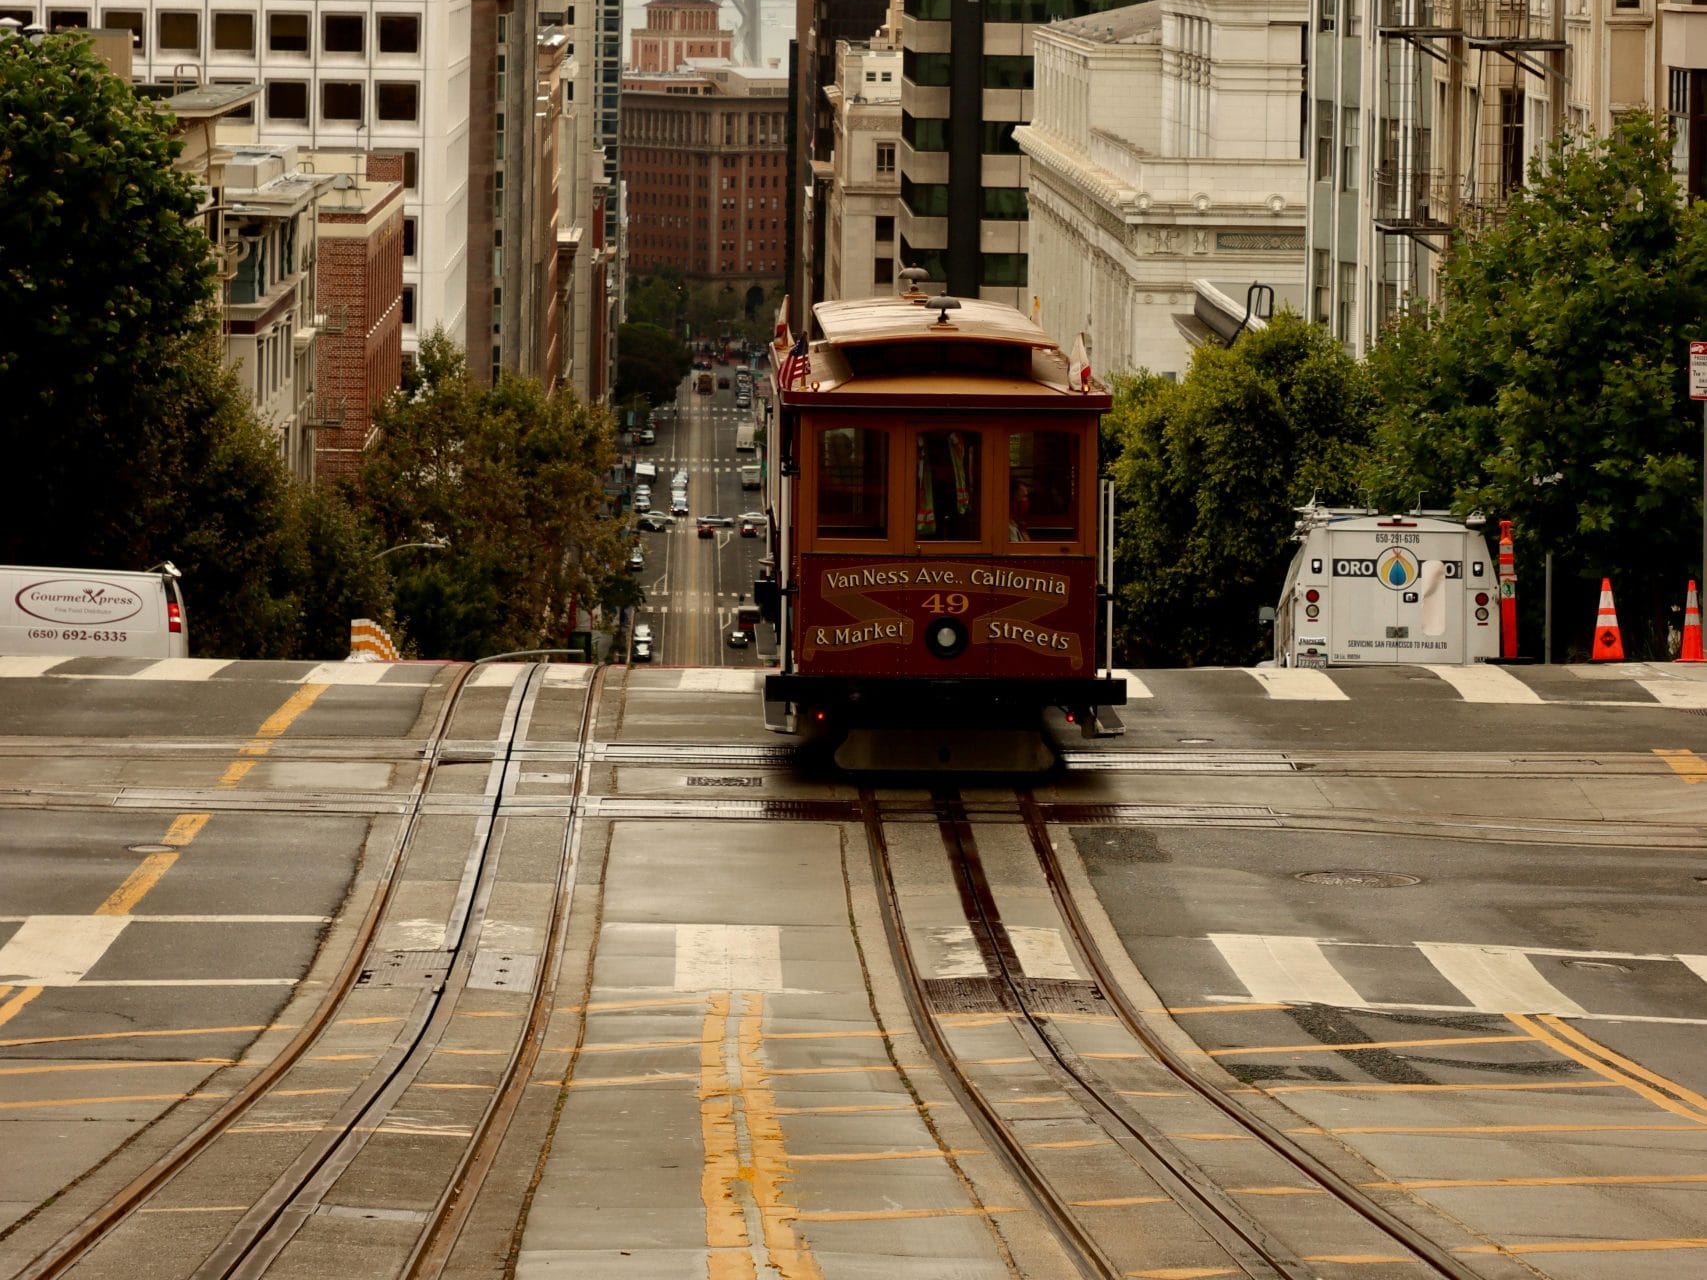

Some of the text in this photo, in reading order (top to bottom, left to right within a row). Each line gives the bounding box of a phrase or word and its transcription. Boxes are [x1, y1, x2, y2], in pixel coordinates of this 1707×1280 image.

[1376, 533, 1420, 544] 650-291-6376
[1337, 561, 1374, 575] ORO
[826, 573, 860, 589] Van
[862, 569, 909, 586] Ness
[971, 569, 1066, 595] California
[921, 593, 969, 614] 49
[28, 629, 127, 642] (650) 692-6335
[816, 621, 1070, 650] & Market Streets
[1374, 640, 1385, 648] SAN
[1385, 640, 1413, 648] FRANCISCO
[1421, 641, 1434, 649] PALO
